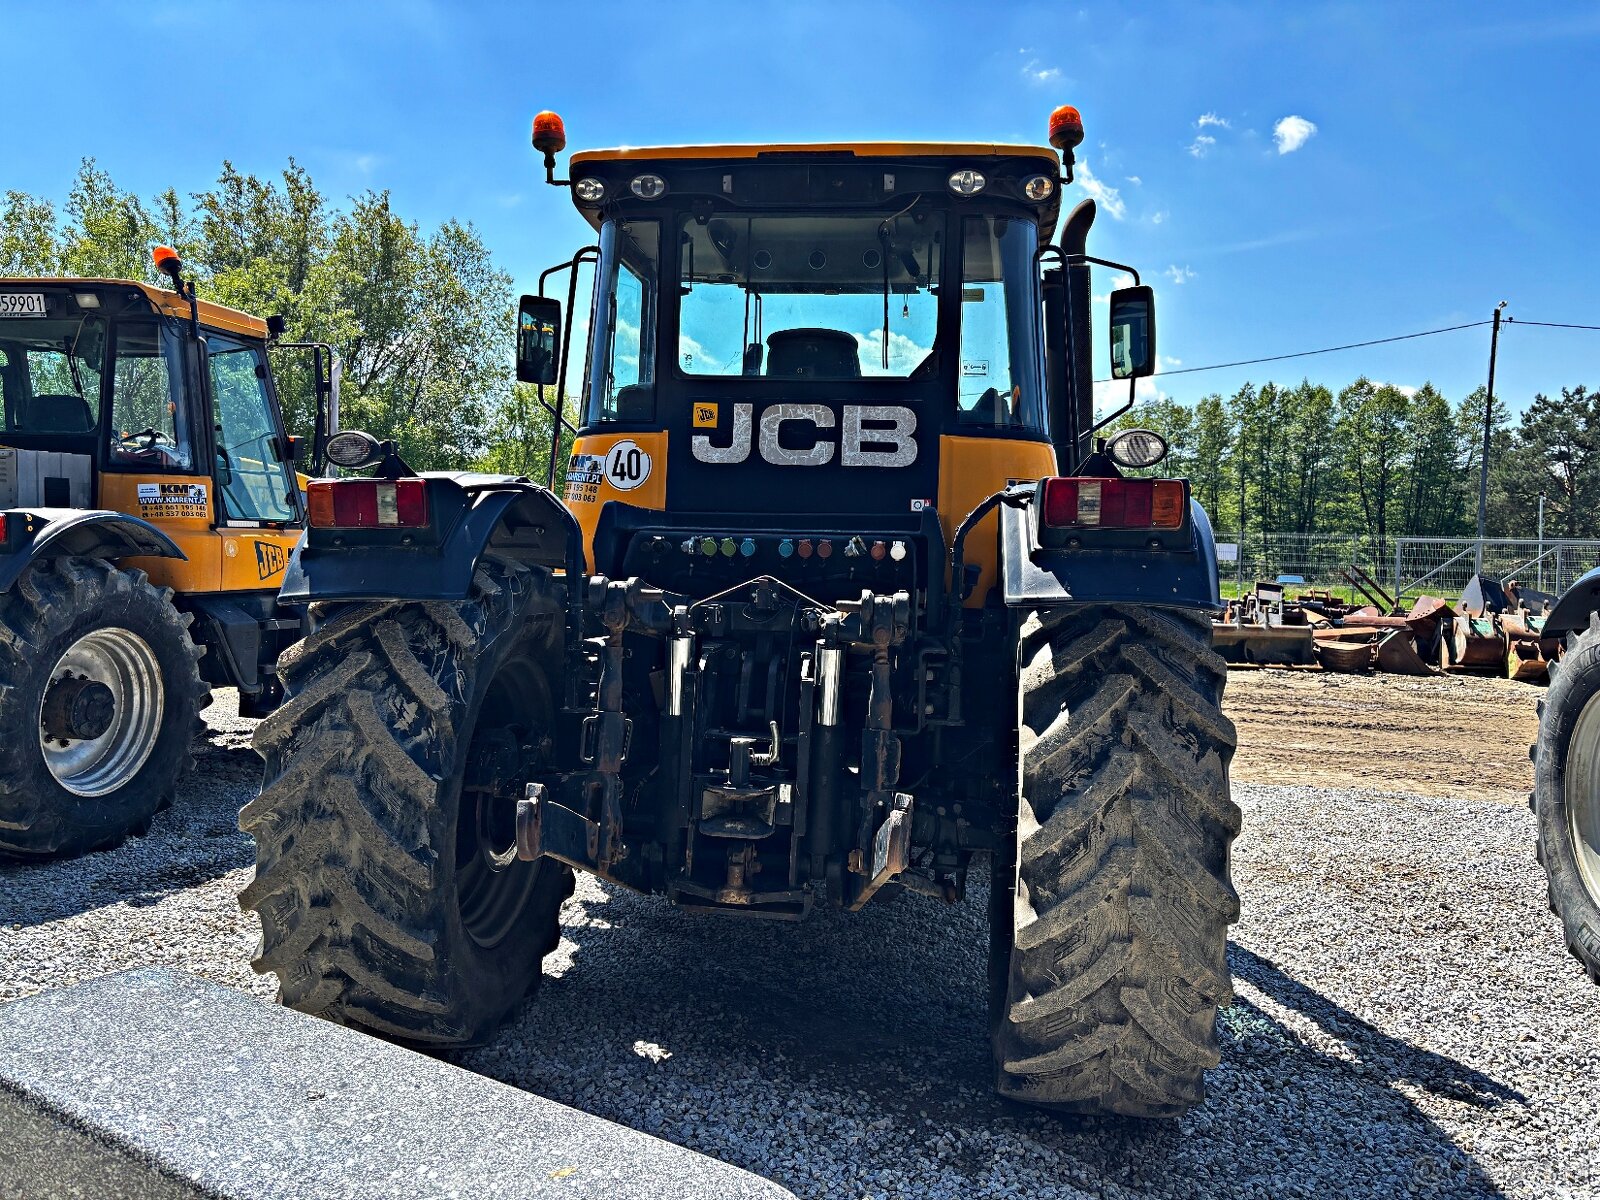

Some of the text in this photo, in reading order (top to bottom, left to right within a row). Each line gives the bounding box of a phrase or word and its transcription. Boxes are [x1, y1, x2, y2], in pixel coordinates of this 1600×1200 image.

[0, 295, 42, 312] 59901
[692, 403, 918, 467] JCB
[612, 448, 641, 481] 40
[161, 484, 189, 493] KM
[255, 541, 284, 579] JCB
